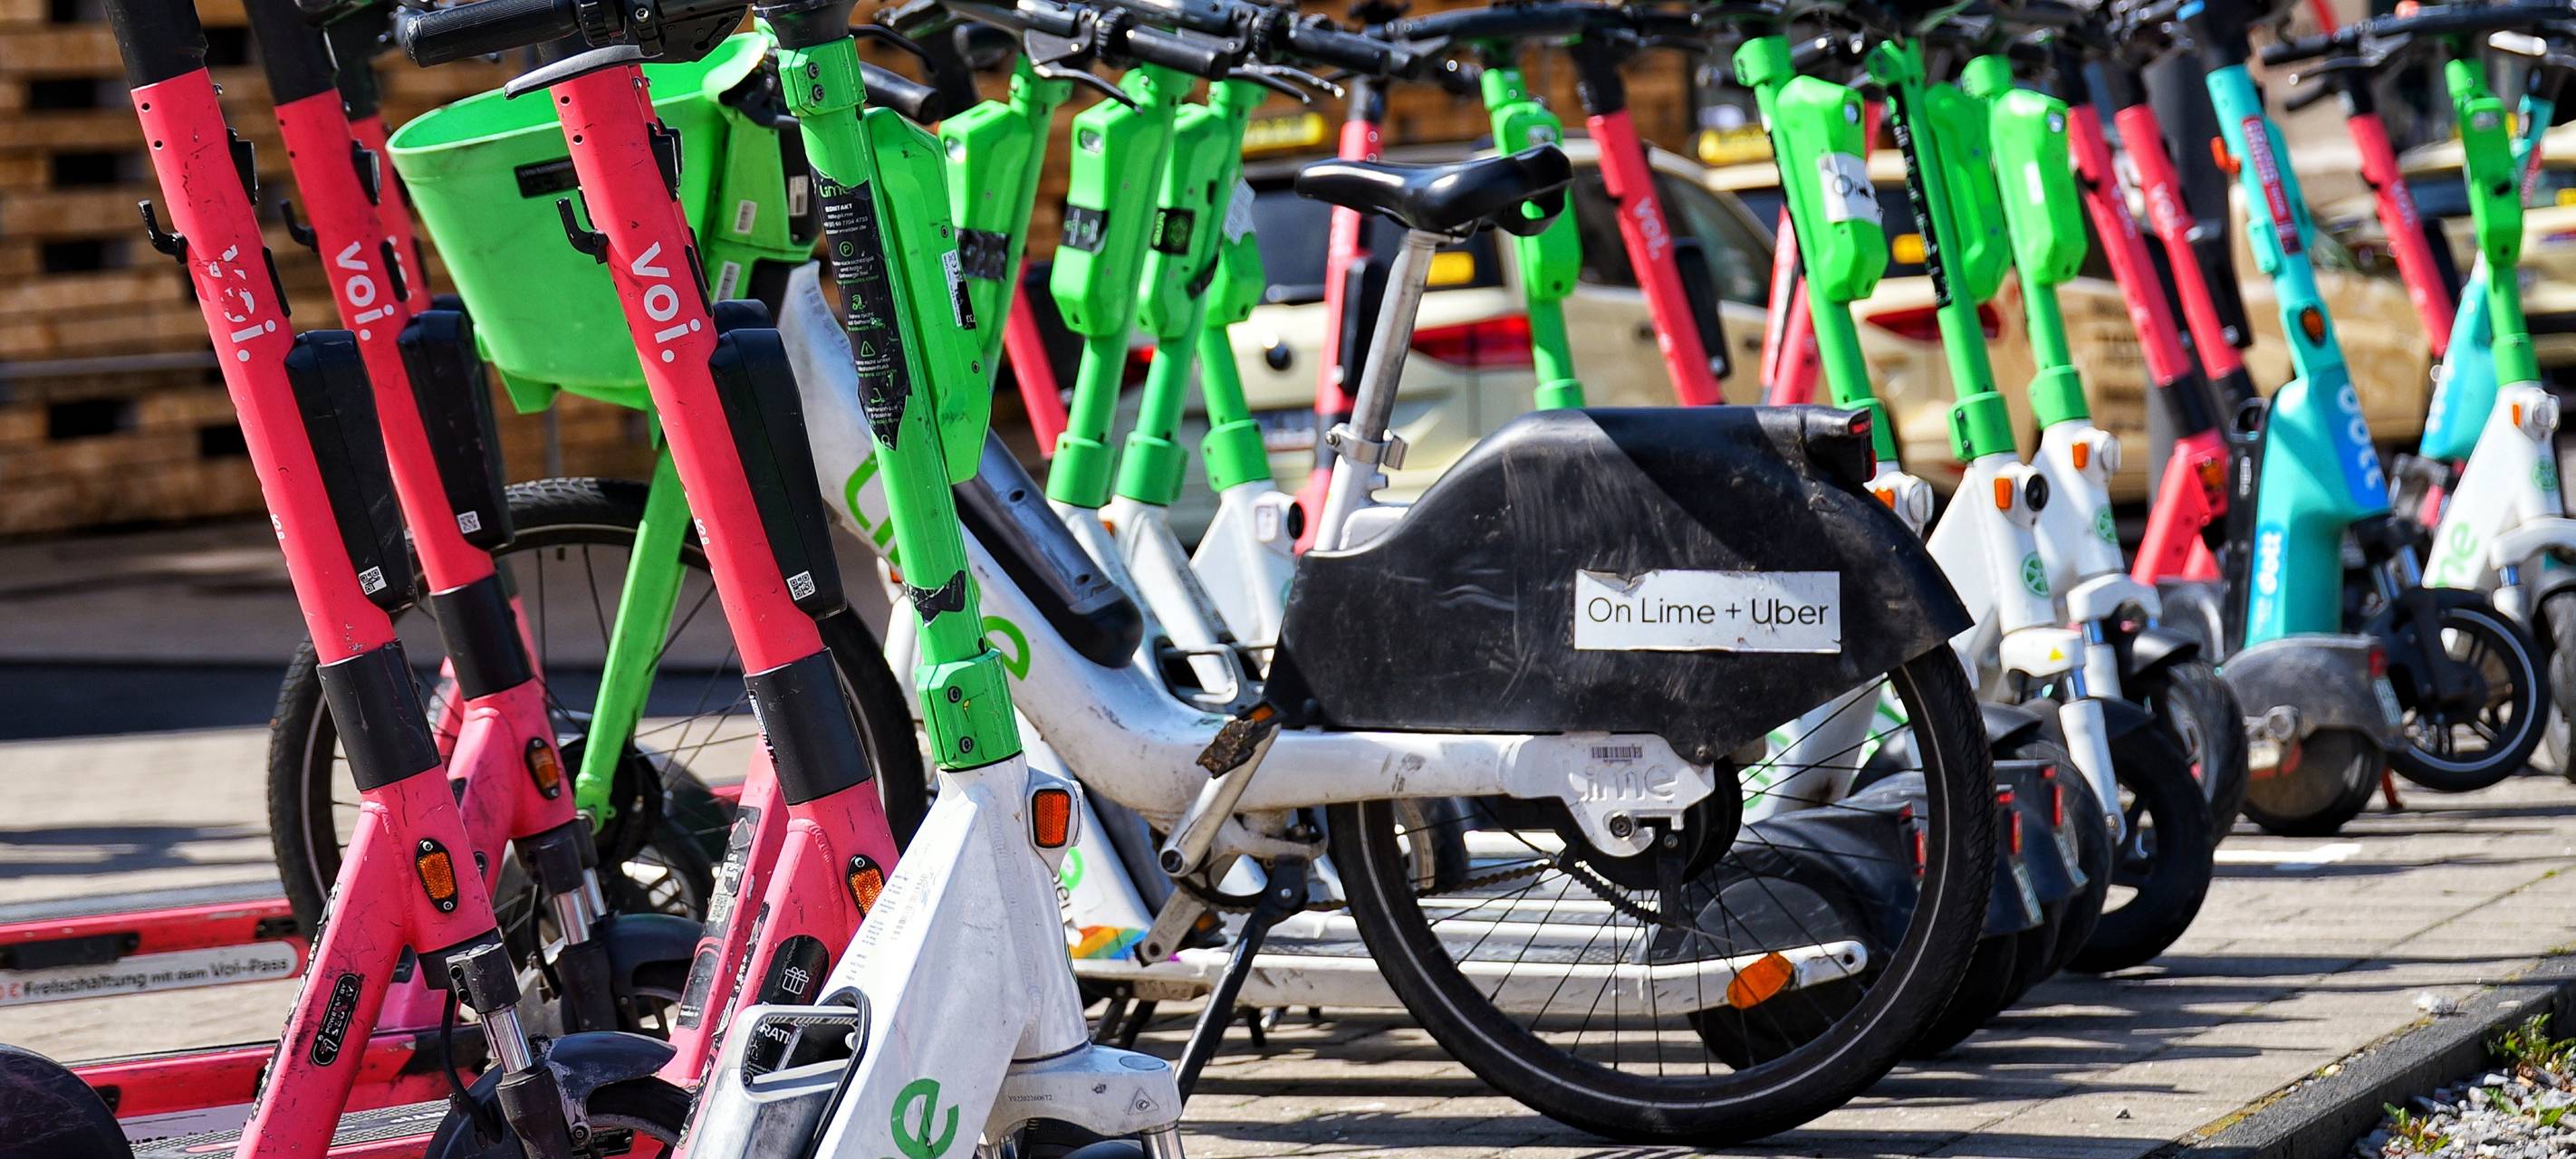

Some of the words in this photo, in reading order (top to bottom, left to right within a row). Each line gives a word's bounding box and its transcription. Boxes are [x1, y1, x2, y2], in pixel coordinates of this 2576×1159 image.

[824, 203, 852, 213] KONTAKT
[335, 241, 395, 341] voi.
[630, 241, 701, 363] voi.
[1588, 597, 1631, 623] On
[1641, 597, 1716, 624] Lime
[1725, 602, 1742, 619] +
[1751, 597, 1830, 626] Uber
[150, 972, 174, 983] mit
[177, 967, 208, 981] dem
[209, 956, 289, 978] Voi-Pass
